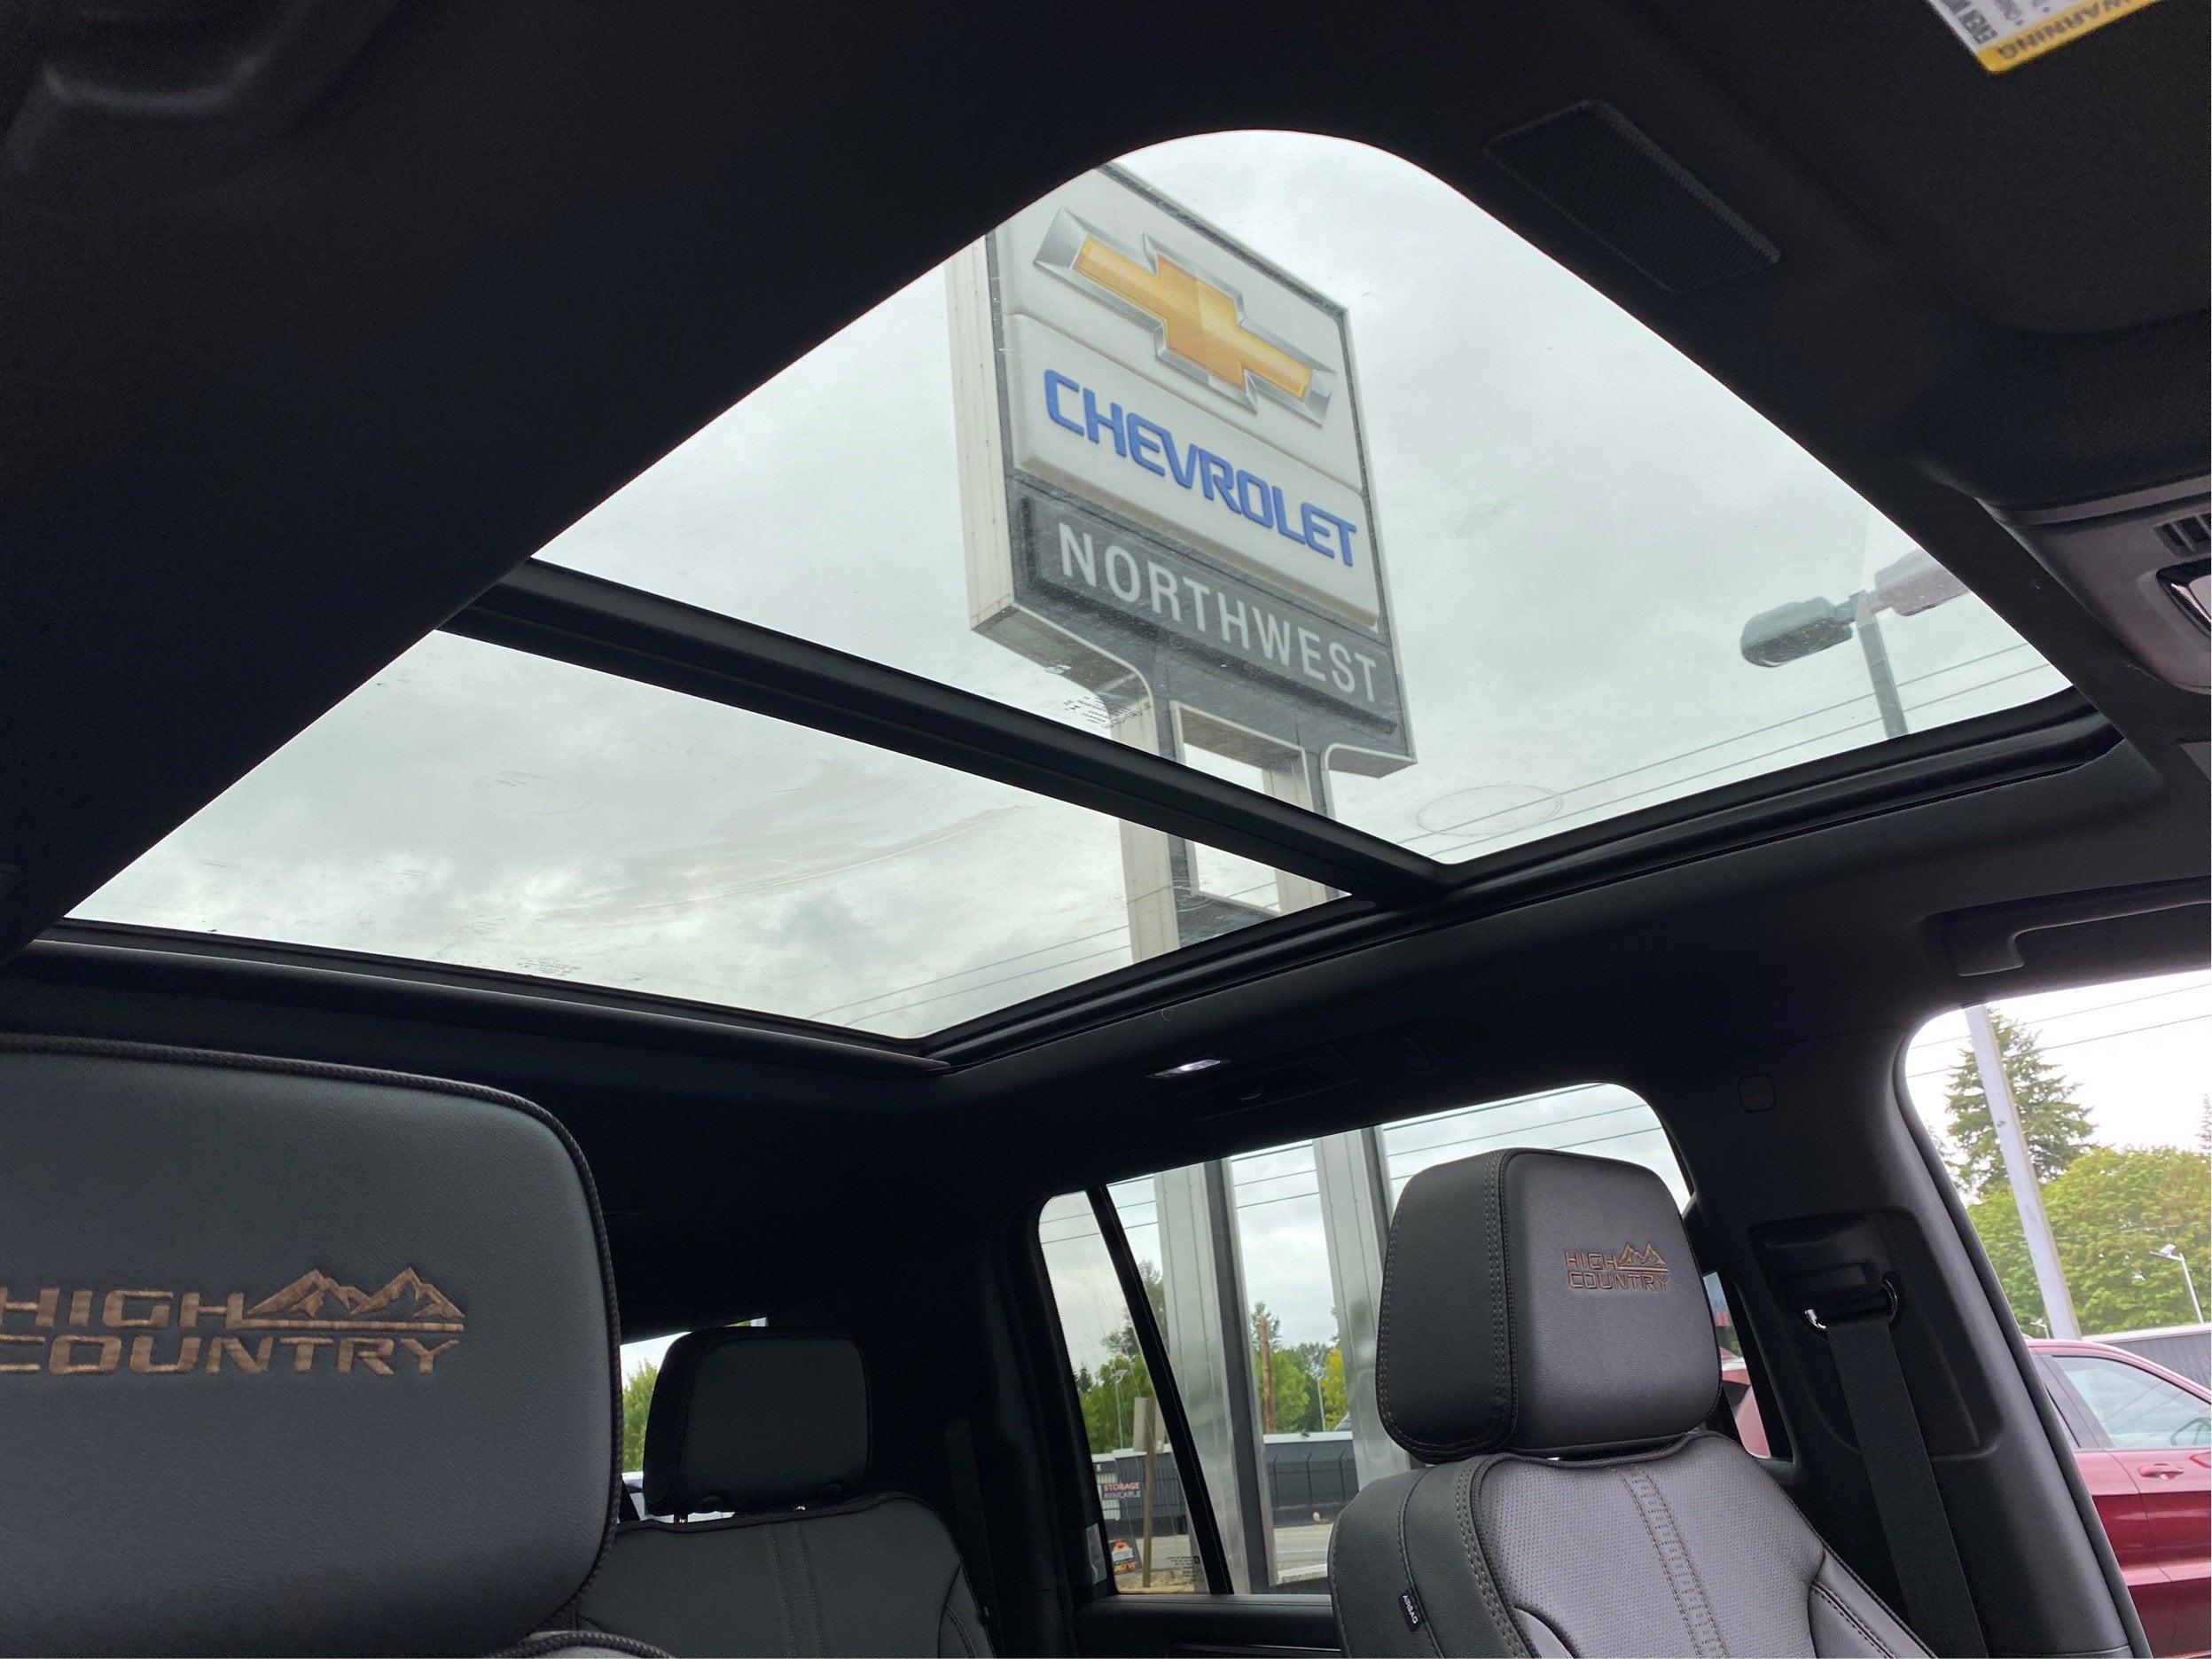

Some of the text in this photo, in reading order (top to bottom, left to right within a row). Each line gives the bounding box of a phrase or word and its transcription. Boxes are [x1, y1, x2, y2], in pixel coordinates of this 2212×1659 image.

[1043, 369, 1357, 567] CHEVROLET
[1059, 521, 1377, 704] NORTHWEST
[1564, 1250, 1619, 1270] HIGH
[1568, 1271, 1669, 1291] COUNTRY
[0, 1286, 245, 1329] HIGH
[1103, 1482, 1141, 1491] STORAGE
